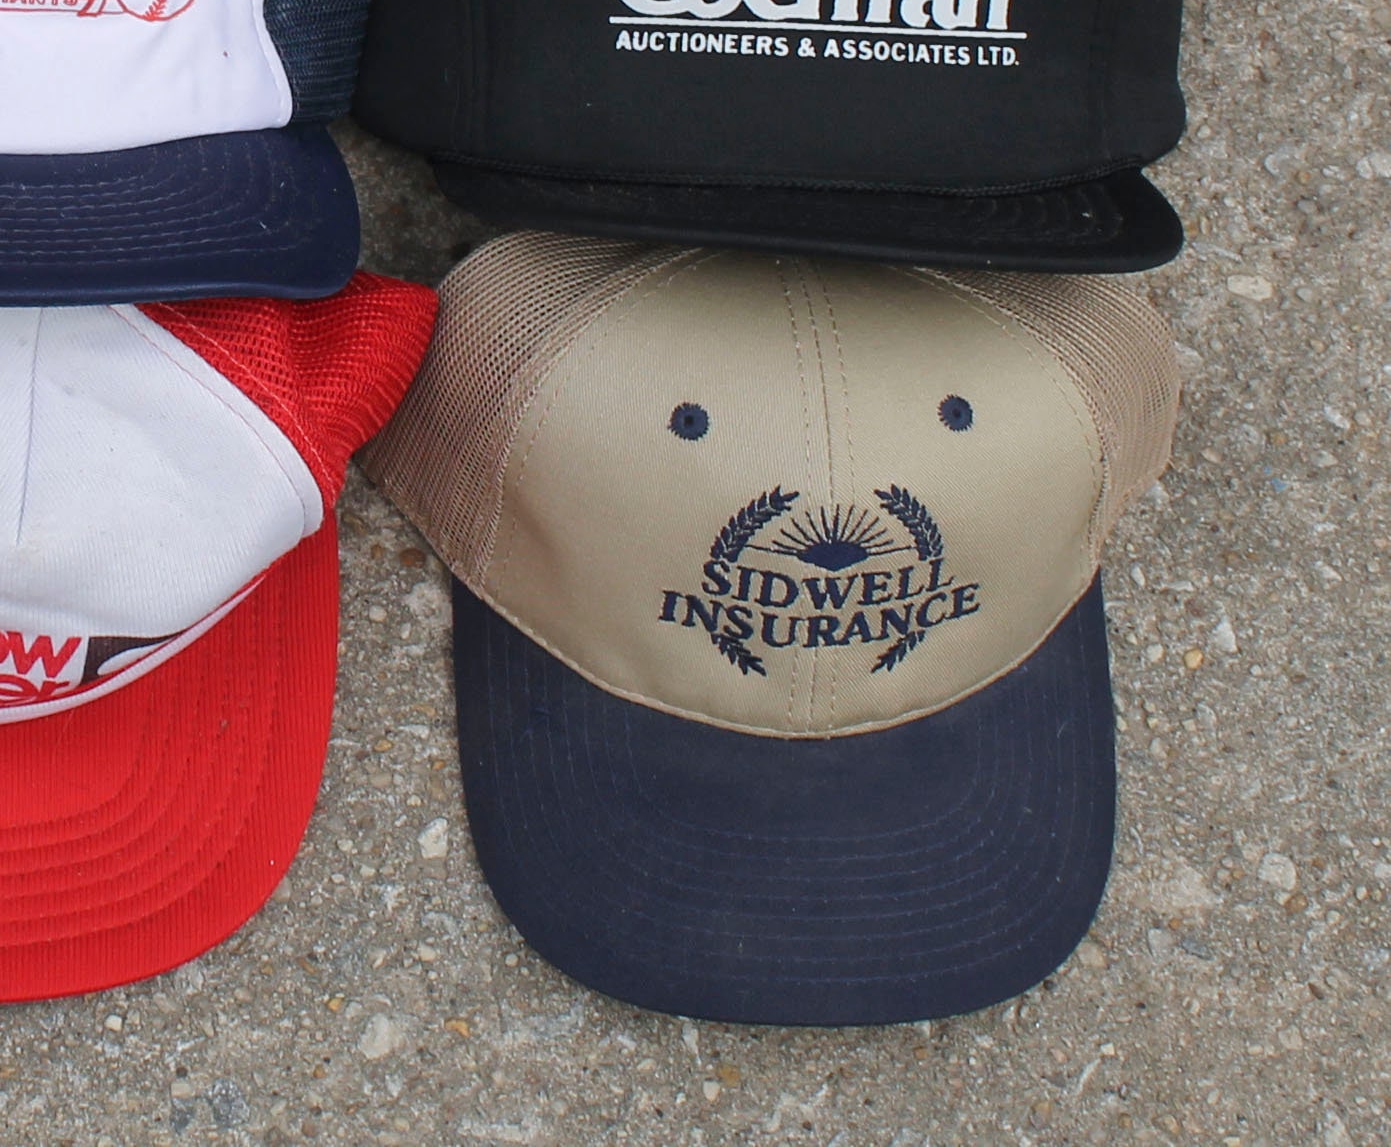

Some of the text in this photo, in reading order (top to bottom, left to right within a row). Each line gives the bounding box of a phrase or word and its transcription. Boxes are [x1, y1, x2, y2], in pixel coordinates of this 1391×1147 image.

[615, 30, 1020, 67] AUCTIONEERS & ASSOCIATES LTD.
[701, 556, 956, 610] SIDWELL
[657, 582, 981, 648] INSURANCE
